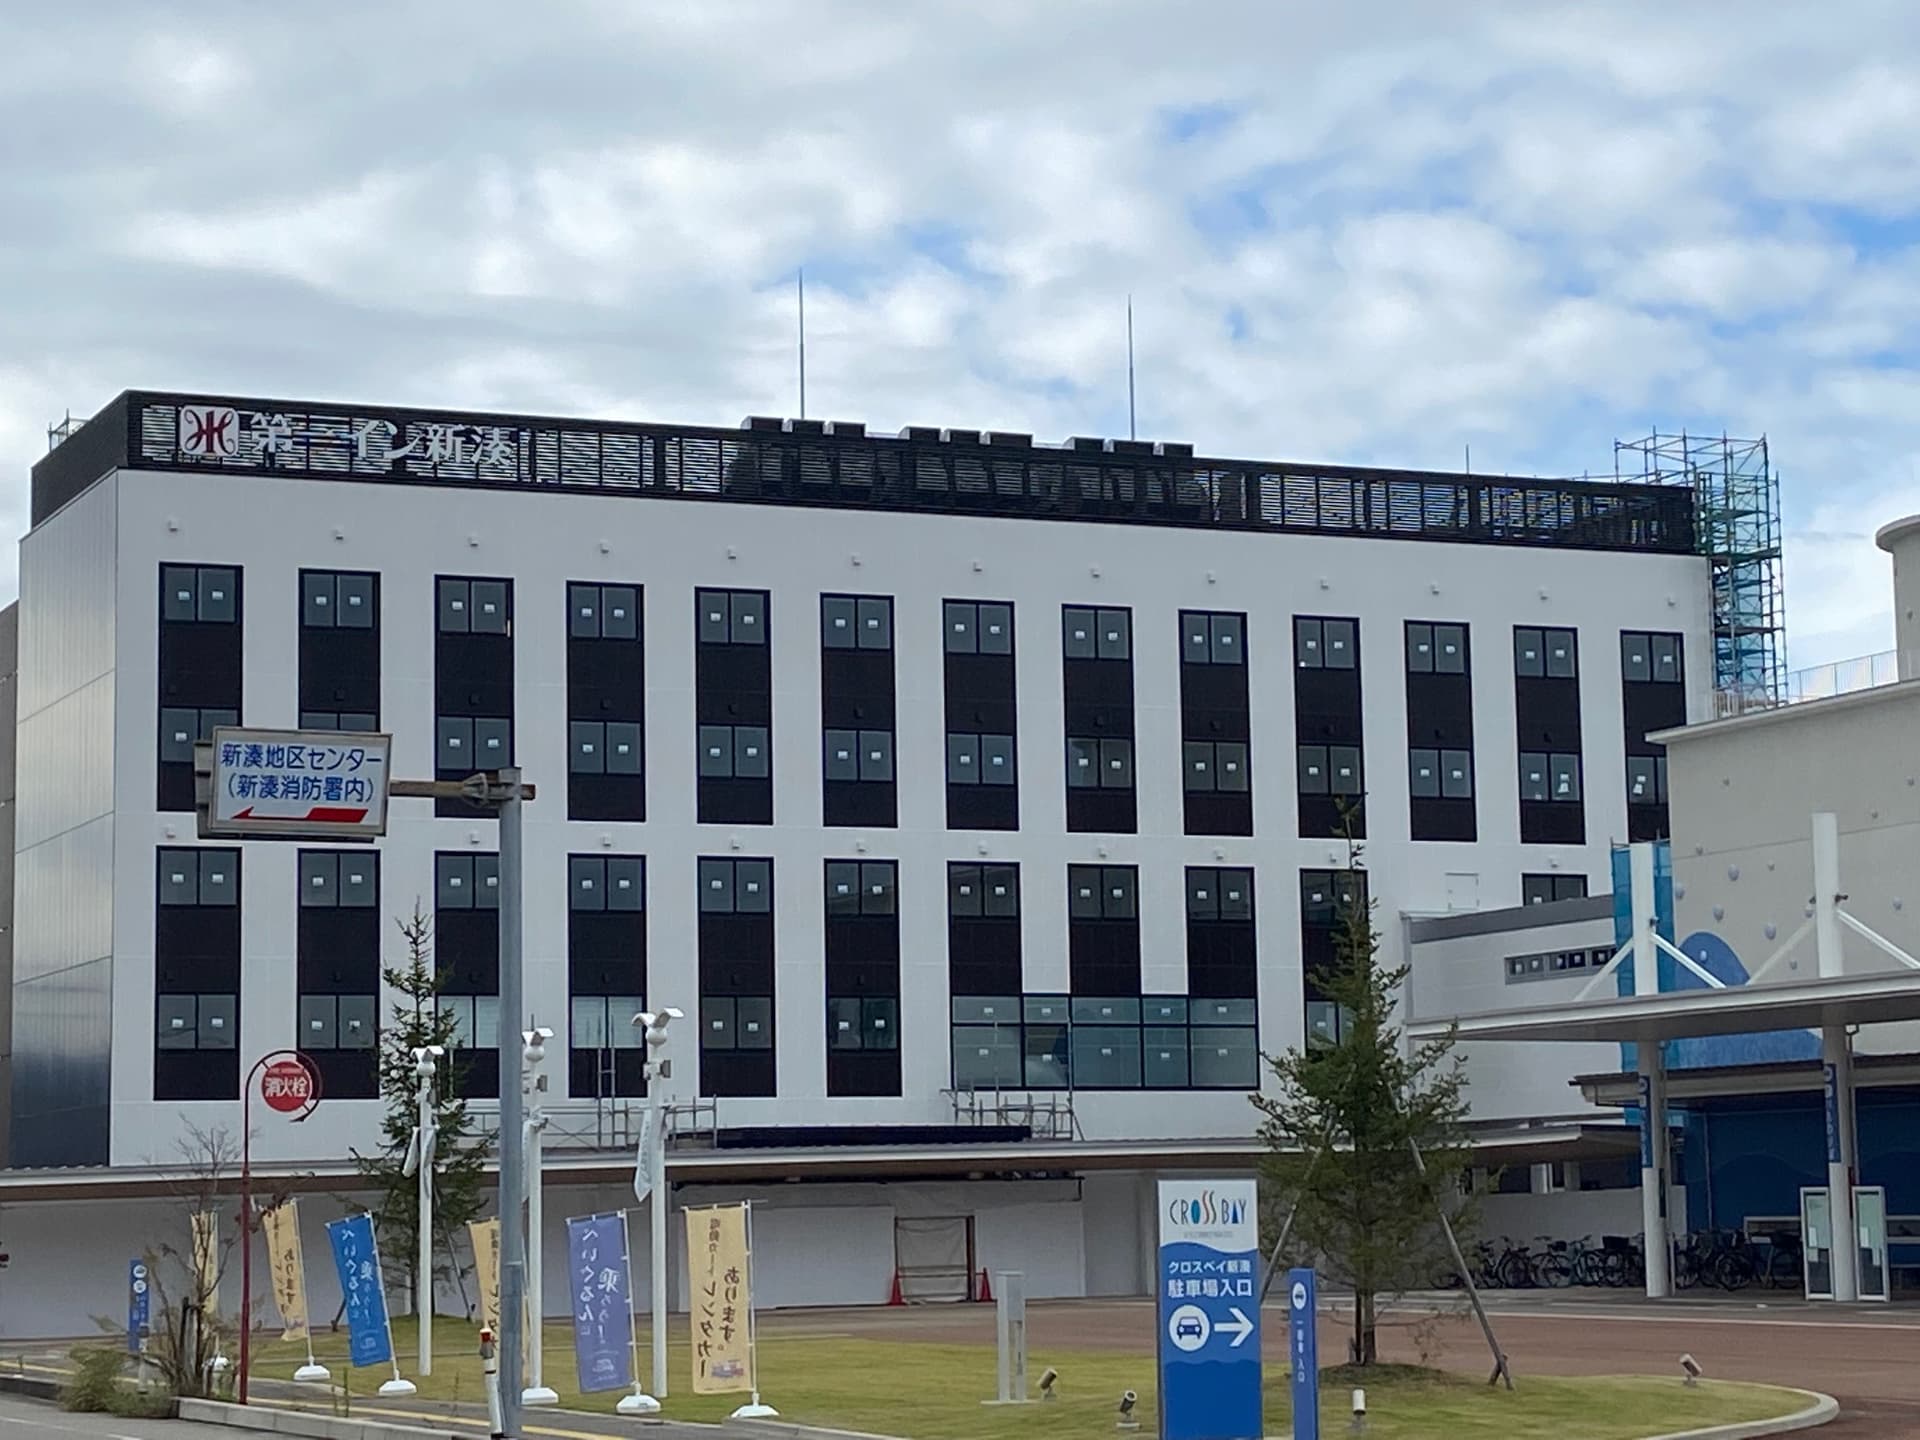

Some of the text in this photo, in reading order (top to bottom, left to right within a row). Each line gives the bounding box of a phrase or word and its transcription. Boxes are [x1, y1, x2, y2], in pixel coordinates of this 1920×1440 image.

[221, 743, 382, 772] 新湊地区センター
[228, 773, 374, 803] （新湊消防署内）
[264, 1076, 308, 1097] 消火栓
[1169, 1190, 1247, 1225] CROSS BAY
[1168, 1279, 1253, 1298] 駐車場入口
